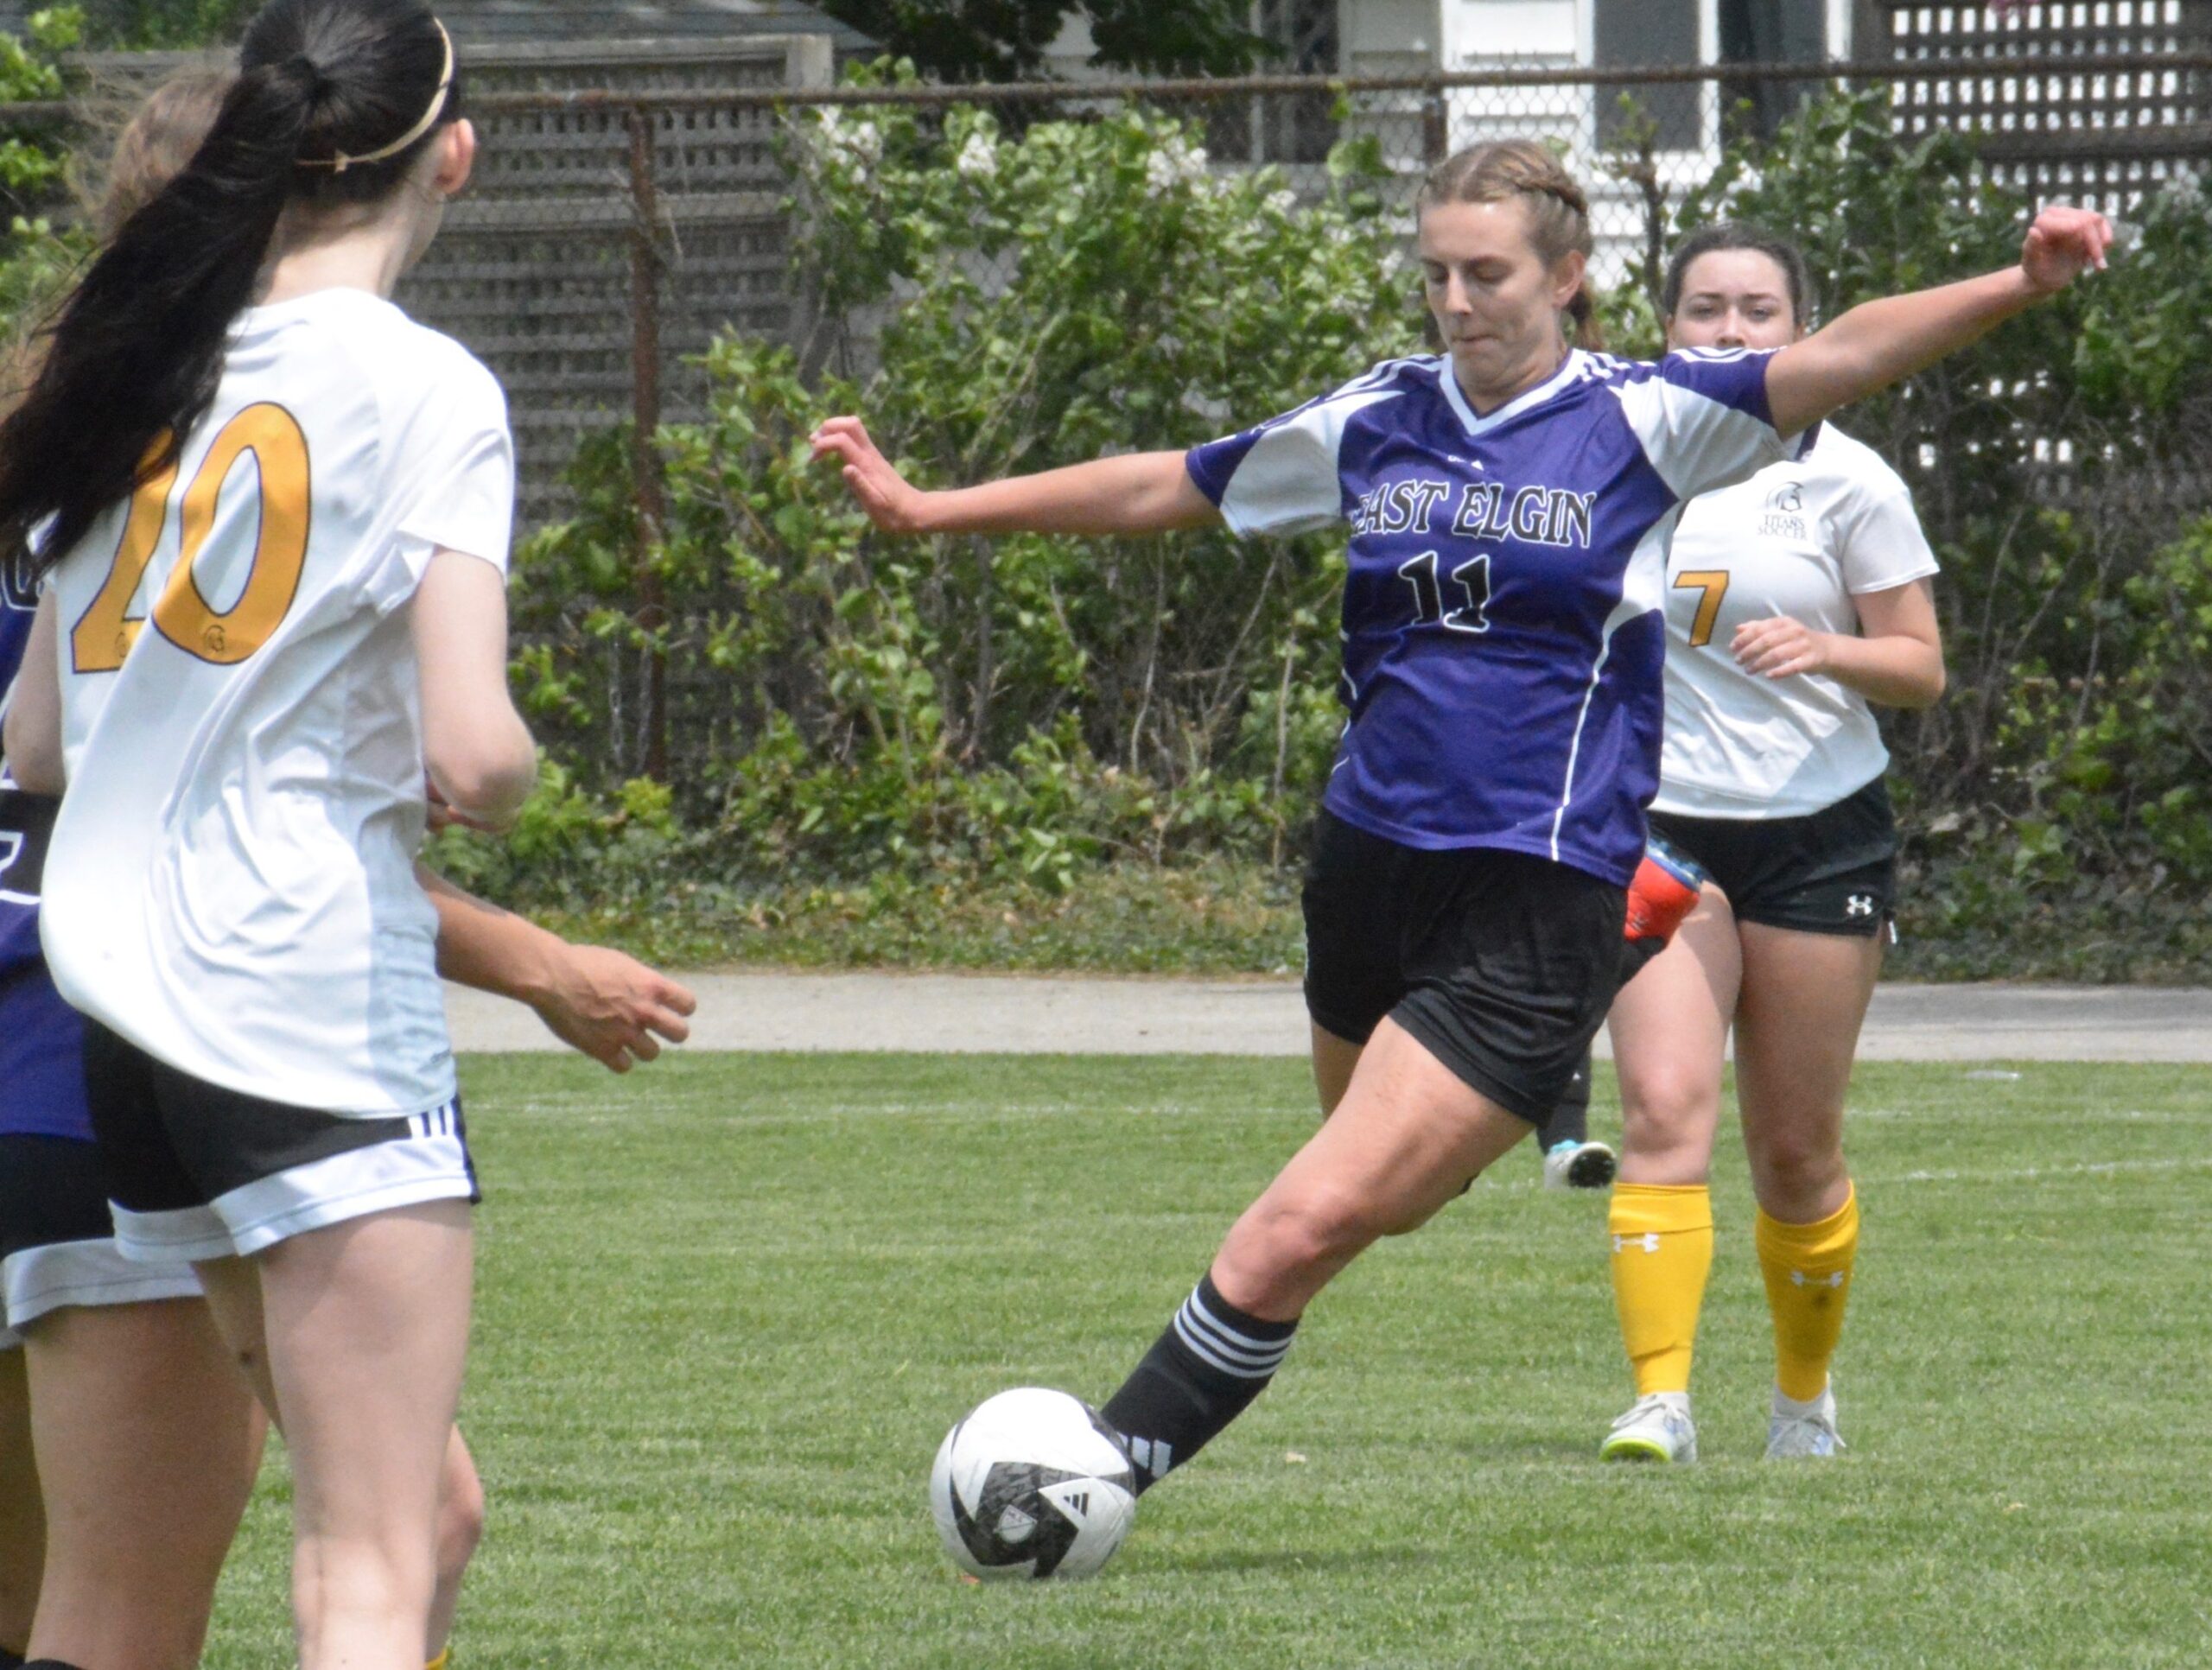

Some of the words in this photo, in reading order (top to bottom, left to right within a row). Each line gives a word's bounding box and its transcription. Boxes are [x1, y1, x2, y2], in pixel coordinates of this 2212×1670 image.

[1452, 481, 1597, 548] ELGIN
[1757, 525, 1808, 541] SOCCER
[1764, 514, 1805, 529] TITANS
[1398, 549, 1491, 633] 11
[1673, 570, 1730, 647] 7
